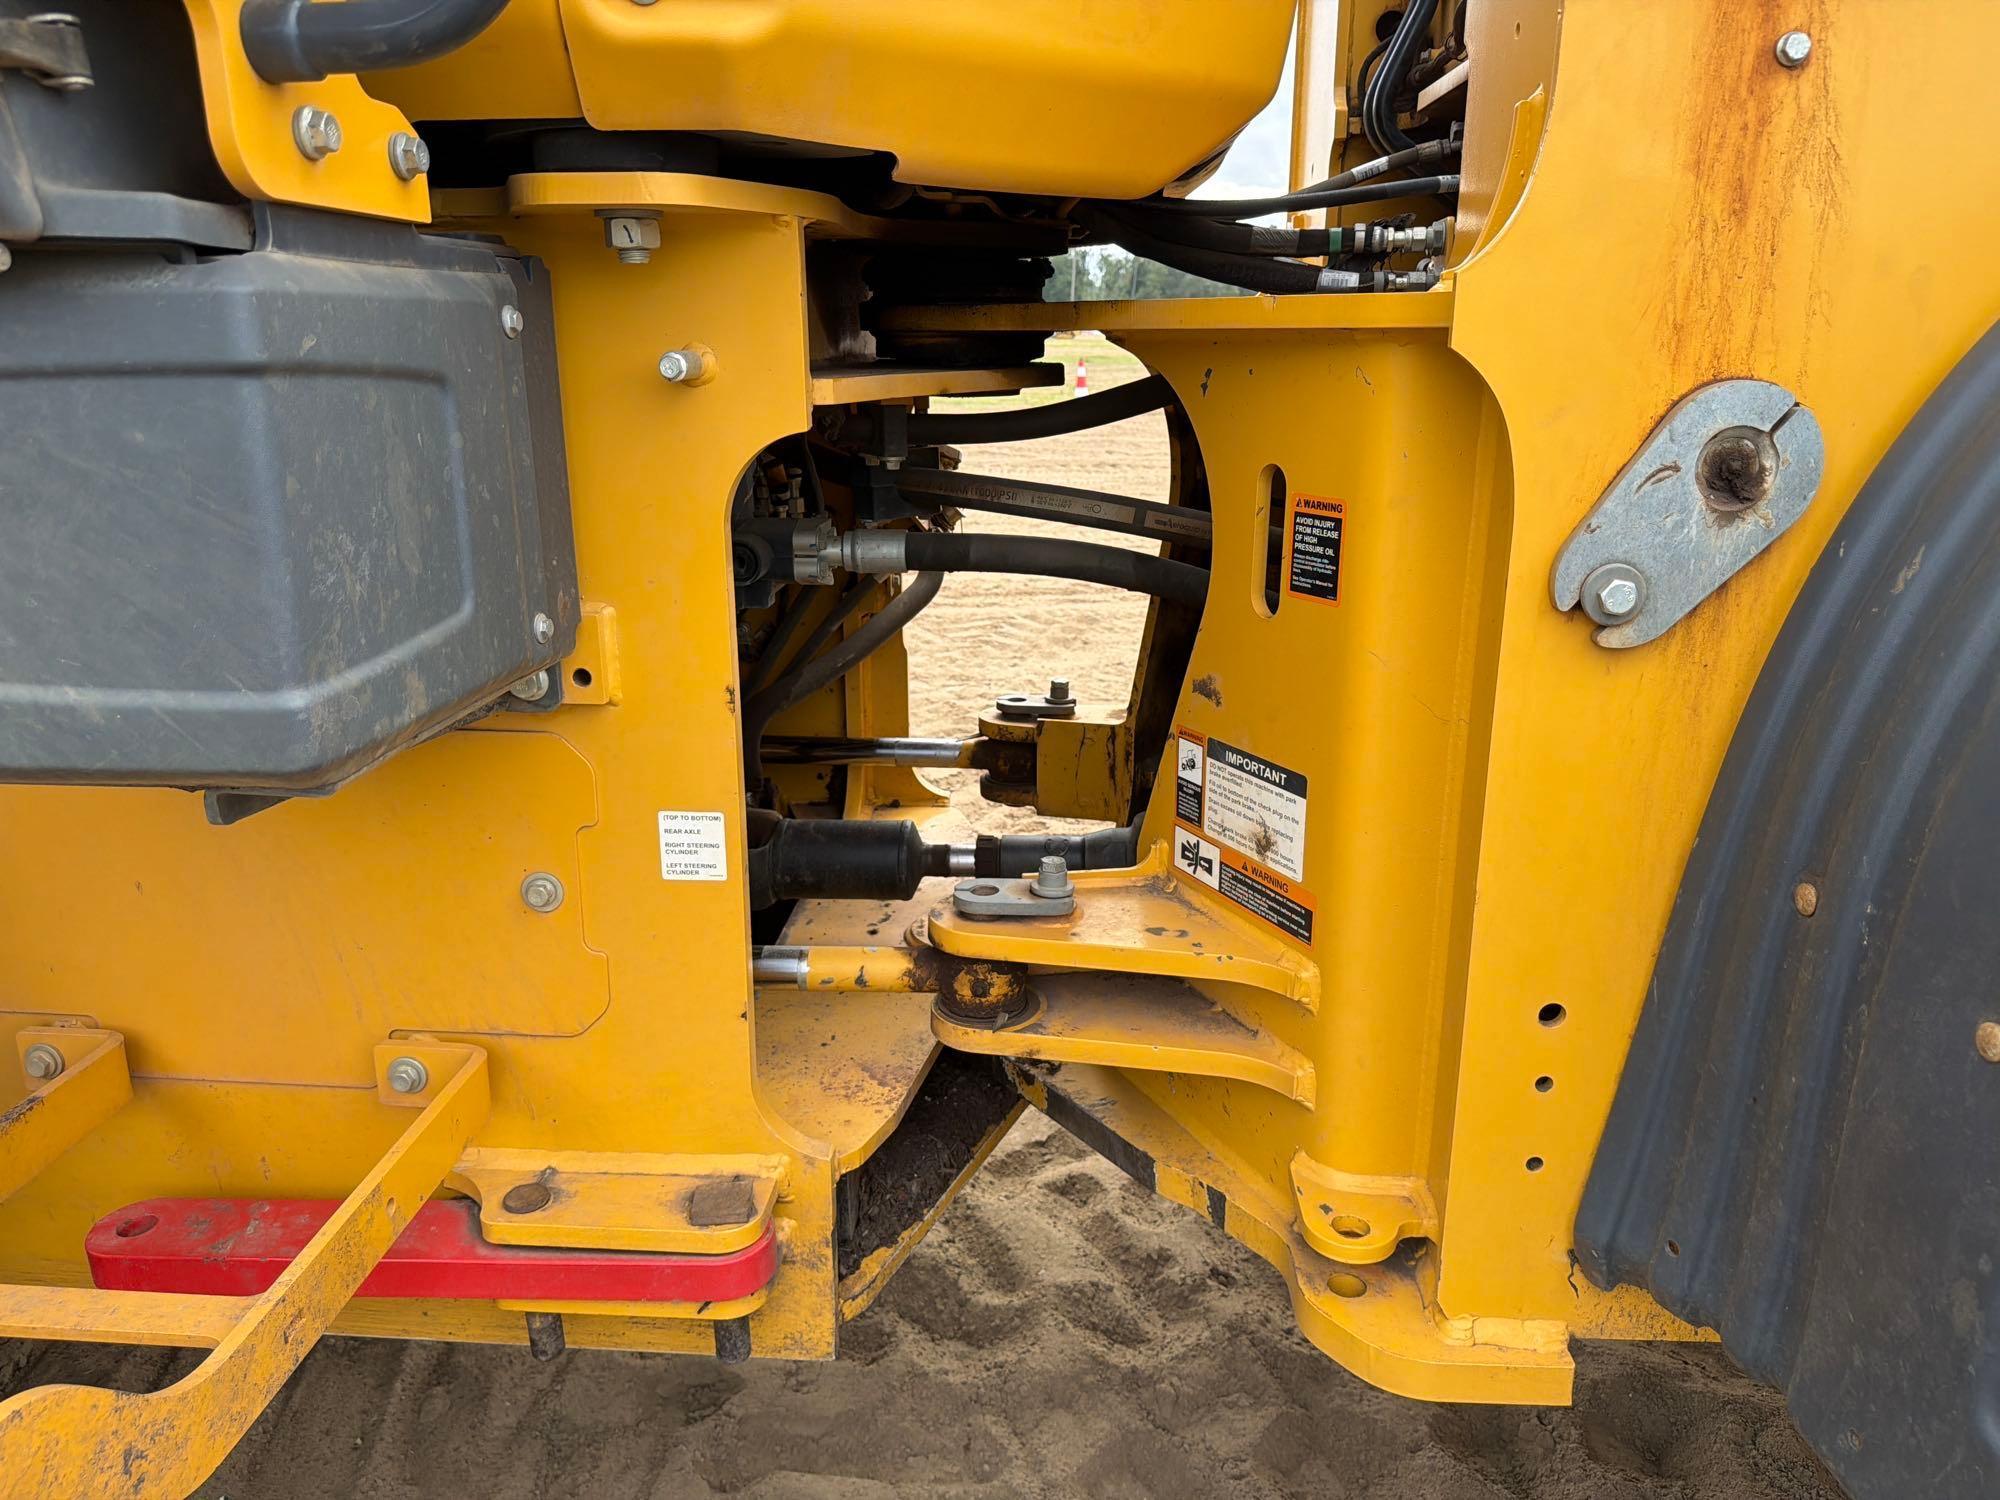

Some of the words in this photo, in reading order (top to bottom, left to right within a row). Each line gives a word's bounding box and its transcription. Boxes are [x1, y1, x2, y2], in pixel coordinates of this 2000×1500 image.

[1304, 499, 1343, 513] WARNING
[1296, 516, 1313, 526] AVOID
[1314, 519, 1335, 529] INJURY
[1295, 525, 1312, 534] FROM
[1313, 528, 1339, 539] RELEASE
[1304, 535, 1318, 544] HIGH
[1294, 542, 1324, 554] PRESSURE
[1325, 547, 1335, 556] OIL
[1225, 750, 1287, 786] IMPORTANT
[1210, 762, 1216, 770] DO
[1218, 765, 1227, 774] NOT
[1228, 770, 1244, 782] operate
[1245, 777, 1253, 786] this
[1254, 781, 1273, 794] machine
[1275, 790, 1284, 799] with
[1286, 795, 1296, 805] park
[1209, 787, 1217, 795] side
[1231, 797, 1241, 806] park
[1228, 788, 1243, 799] bottom
[1258, 801, 1270, 812] check
[1272, 809, 1283, 821] plug
[1251, 866, 1289, 894] WARNING
